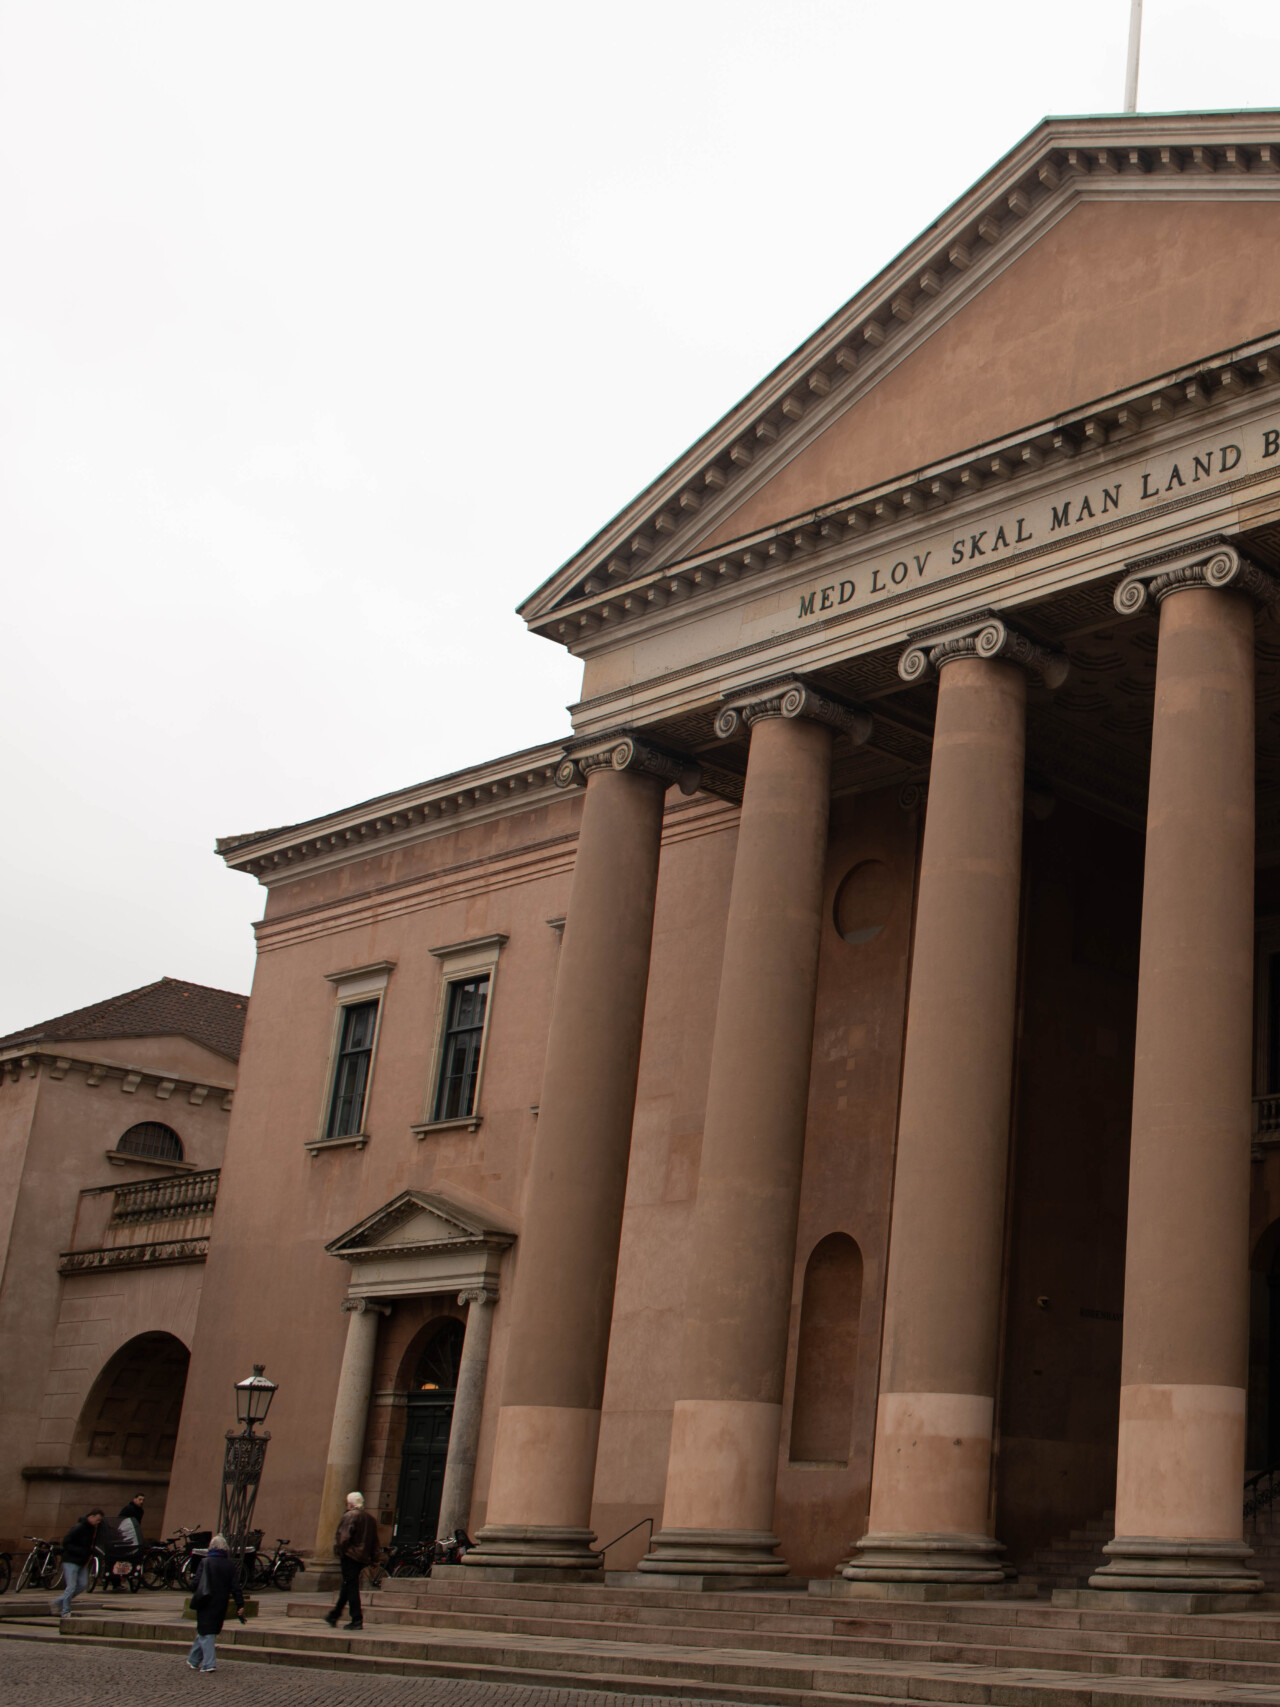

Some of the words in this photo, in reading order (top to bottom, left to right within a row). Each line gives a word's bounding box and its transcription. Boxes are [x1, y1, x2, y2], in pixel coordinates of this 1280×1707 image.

[797, 579, 856, 618] MED
[869, 551, 931, 593] LOV
[951, 517, 1033, 565] SKAL
[1050, 483, 1122, 531] MAN
[1140, 443, 1242, 500] LAND
